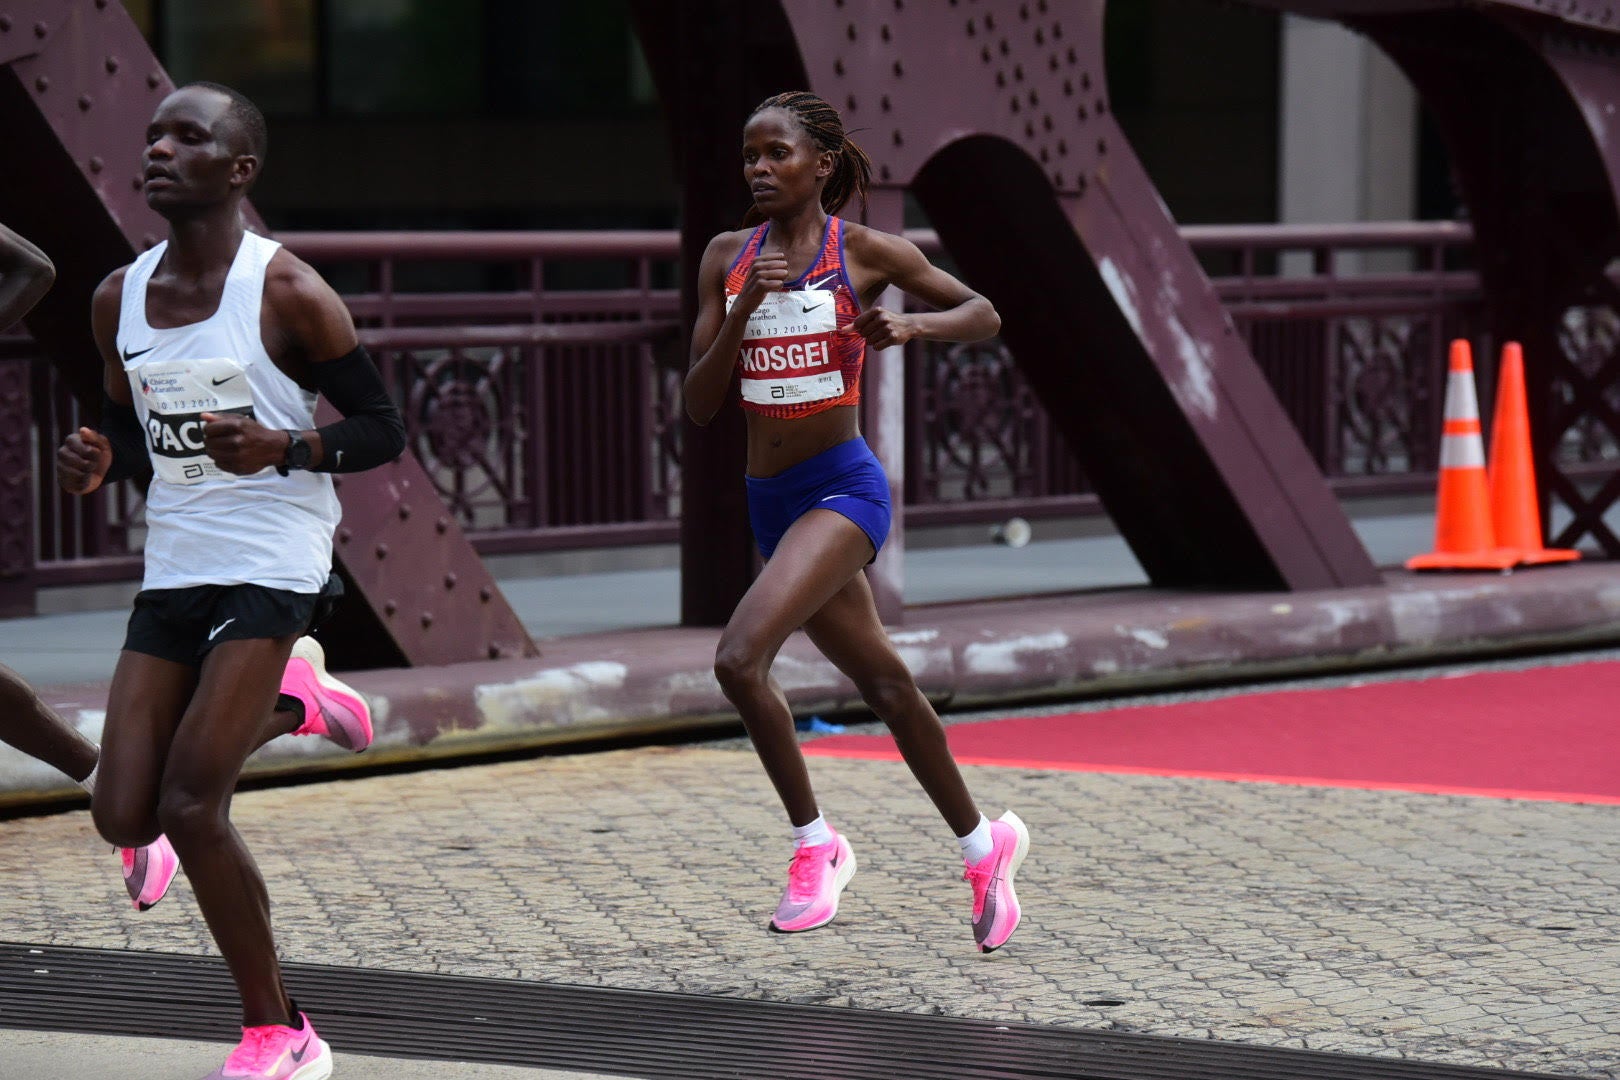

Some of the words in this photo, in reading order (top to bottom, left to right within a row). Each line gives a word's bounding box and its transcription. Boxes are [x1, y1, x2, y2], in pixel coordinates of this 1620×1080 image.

[752, 308, 770, 316] cago
[740, 340, 829, 372] KOSGEI
[149, 378, 178, 386] Chicago
[148, 418, 207, 452] PAC
